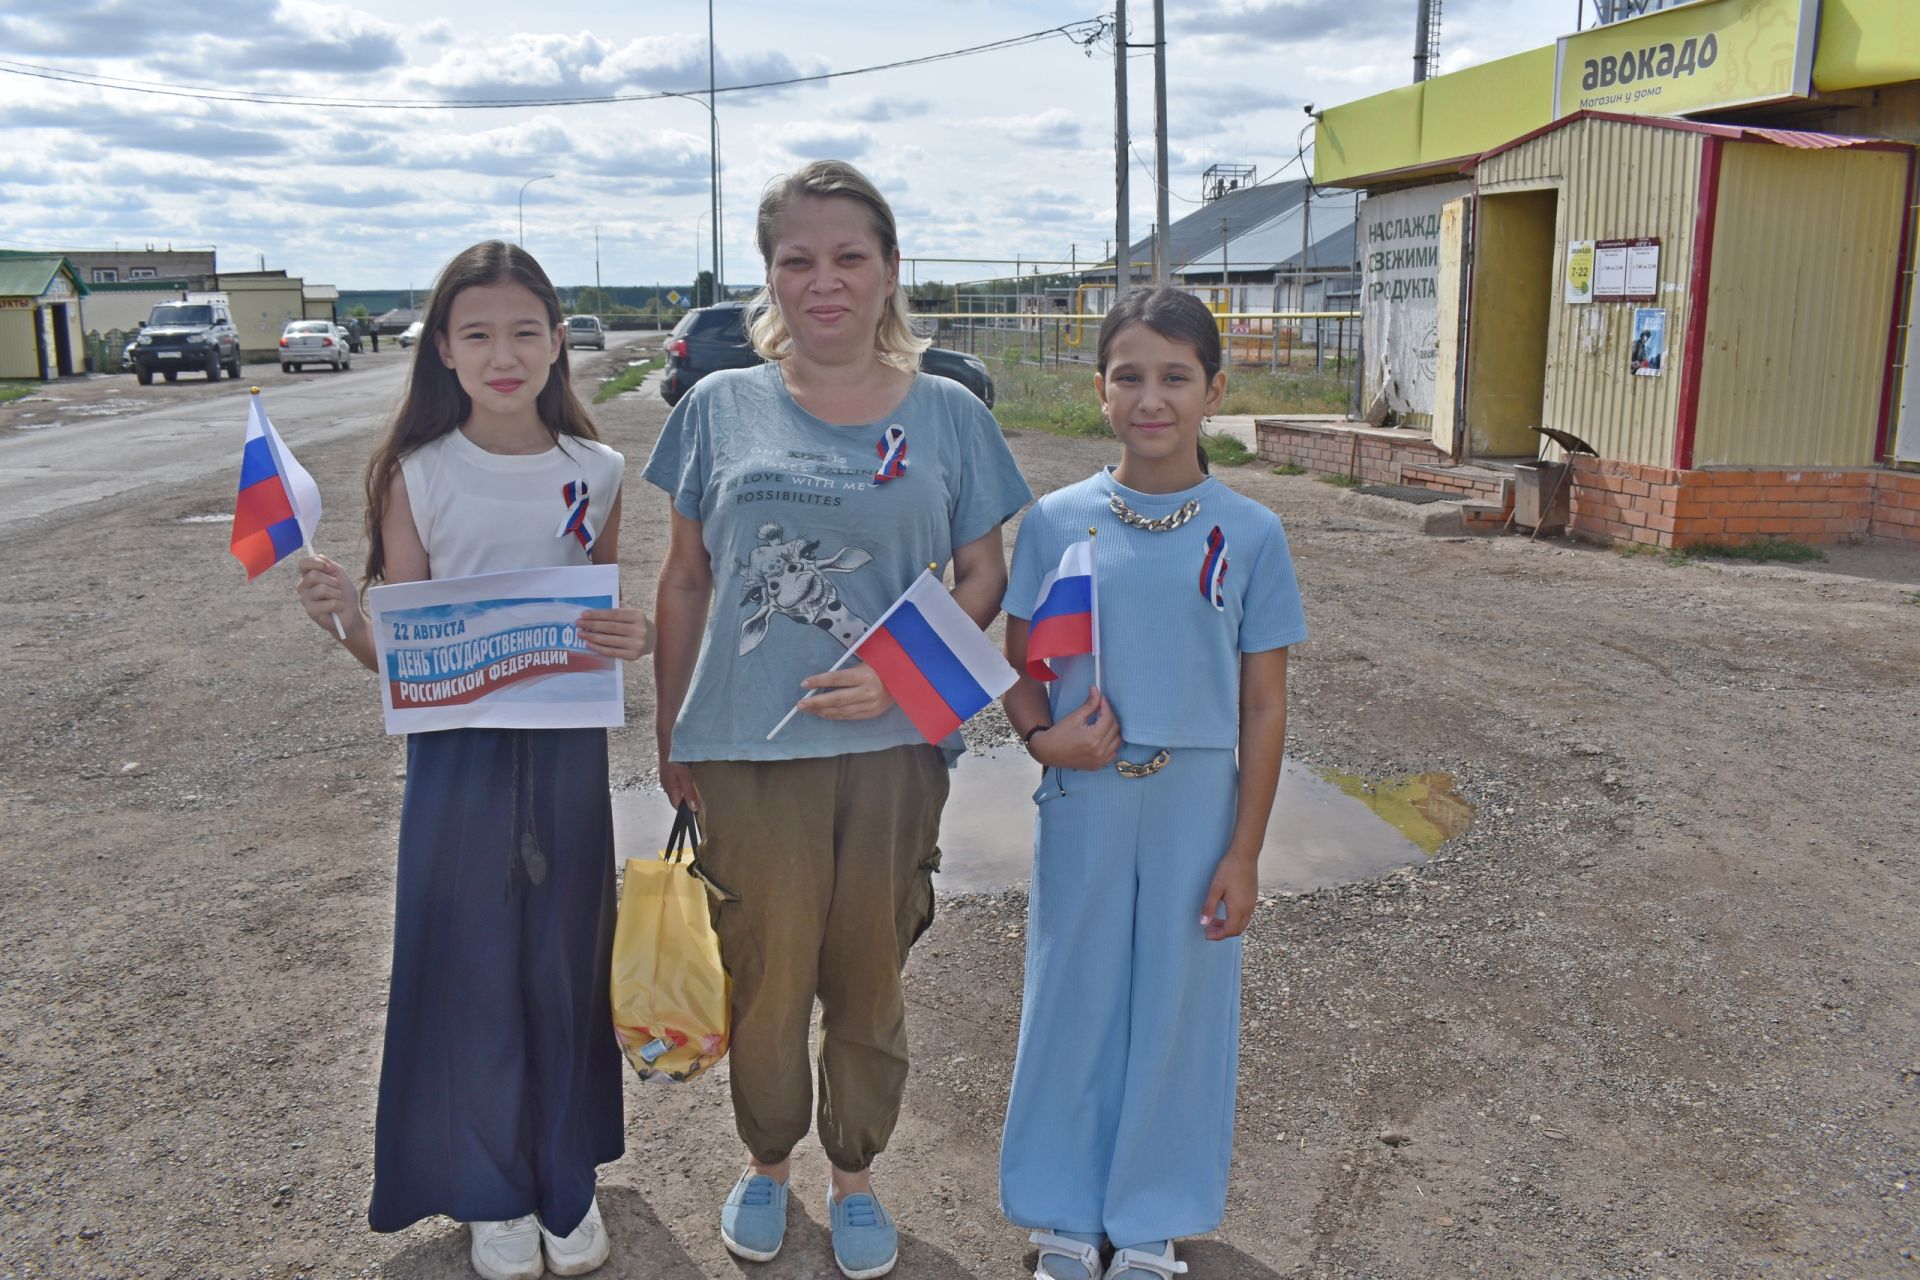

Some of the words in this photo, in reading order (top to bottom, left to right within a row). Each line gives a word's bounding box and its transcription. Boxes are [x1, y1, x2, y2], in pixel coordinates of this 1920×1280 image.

[1580, 95, 1622, 108] Магазин
[1625, 92, 1632, 103] у
[1634, 86, 1662, 101] дома
[1571, 266, 1589, 277] 7-22
[815, 465, 878, 476] FALLIN
[743, 472, 784, 485] LOVE
[791, 476, 834, 489] WITH
[736, 490, 842, 507] POSSIBILITES
[393, 622, 410, 641] 22
[413, 619, 466, 640] АВГУСТА
[397, 650, 431, 679] ДЕНЬ
[433, 626, 557, 675] ГОСУДАРСТВЕННОГО
[399, 672, 485, 703] РОССИЙСКОЙ
[488, 650, 569, 681] ФЕДЕРАЦИИ
